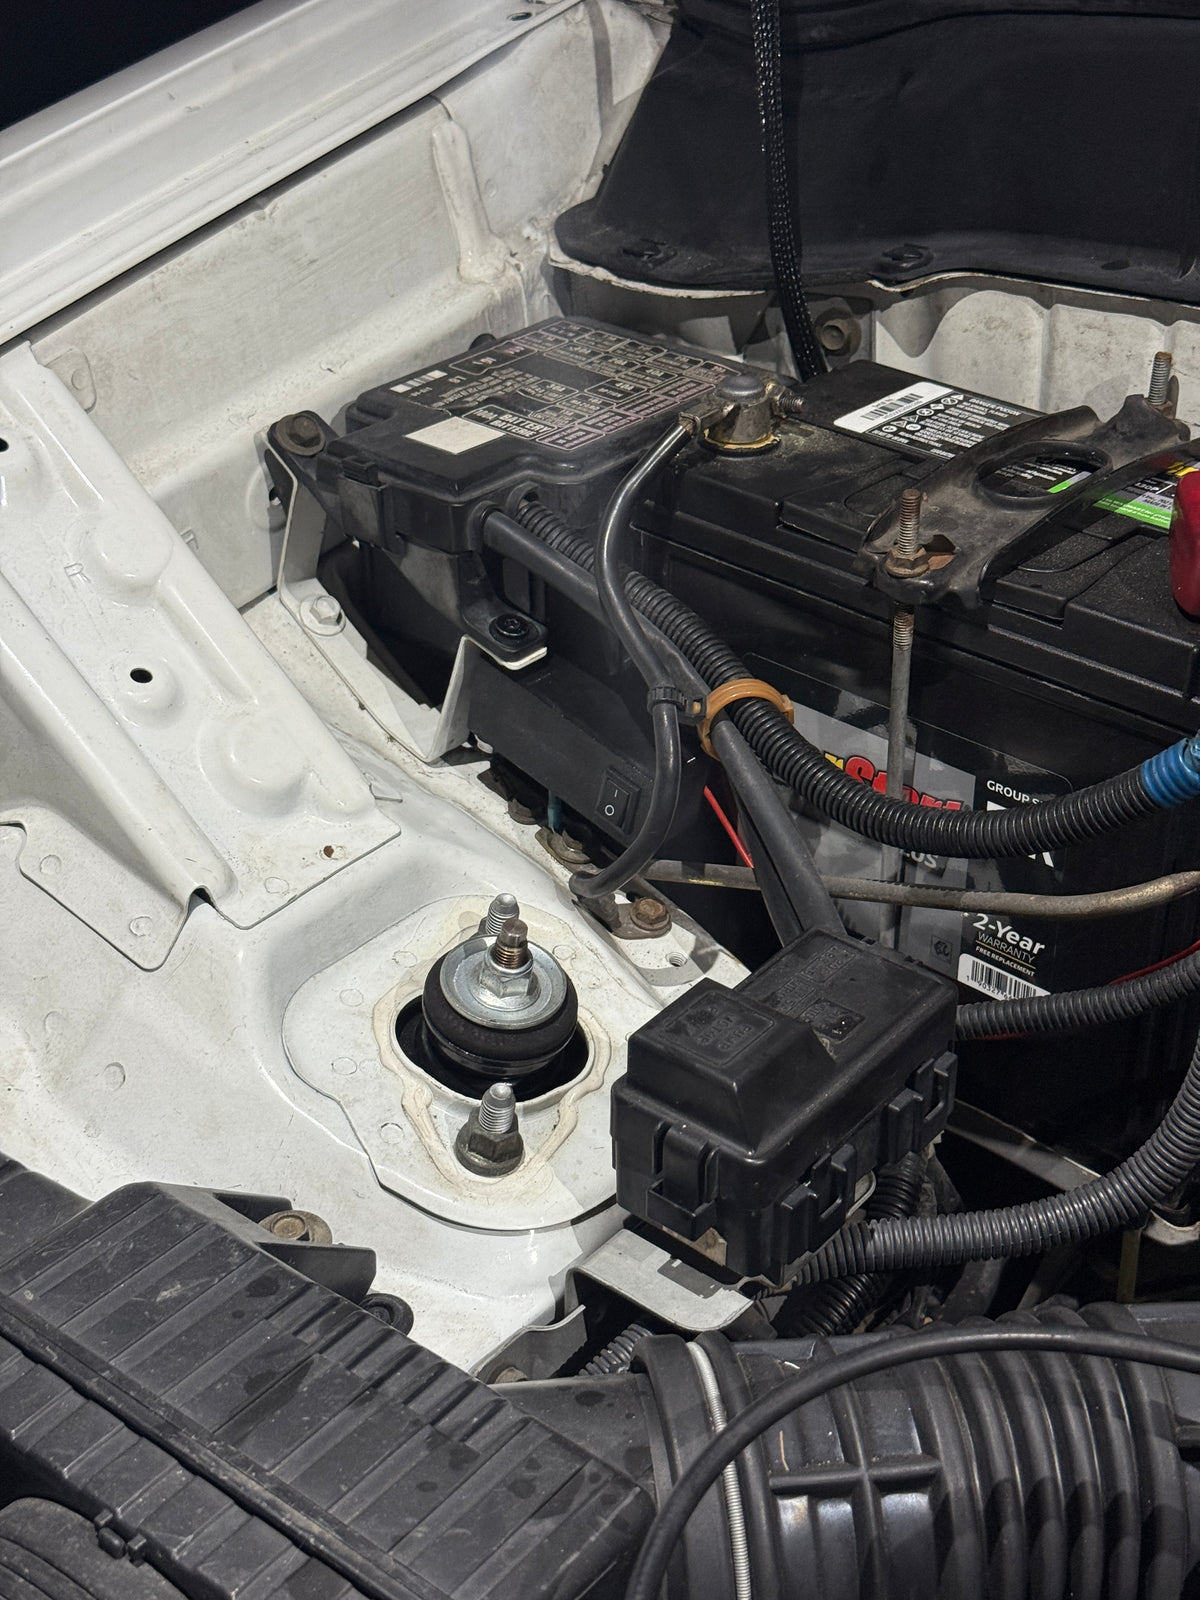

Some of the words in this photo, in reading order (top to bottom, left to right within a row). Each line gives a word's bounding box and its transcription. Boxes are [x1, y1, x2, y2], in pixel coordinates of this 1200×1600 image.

[489, 419, 537, 437] BATTERIE
[499, 413, 552, 433] BATTERY
[986, 779, 1030, 804] GROUP
[972, 912, 1046, 955] 2-Year
[977, 931, 1036, 964] WARRANTY
[975, 945, 991, 958] FREE
[991, 953, 1036, 977] REPLACEMENT
